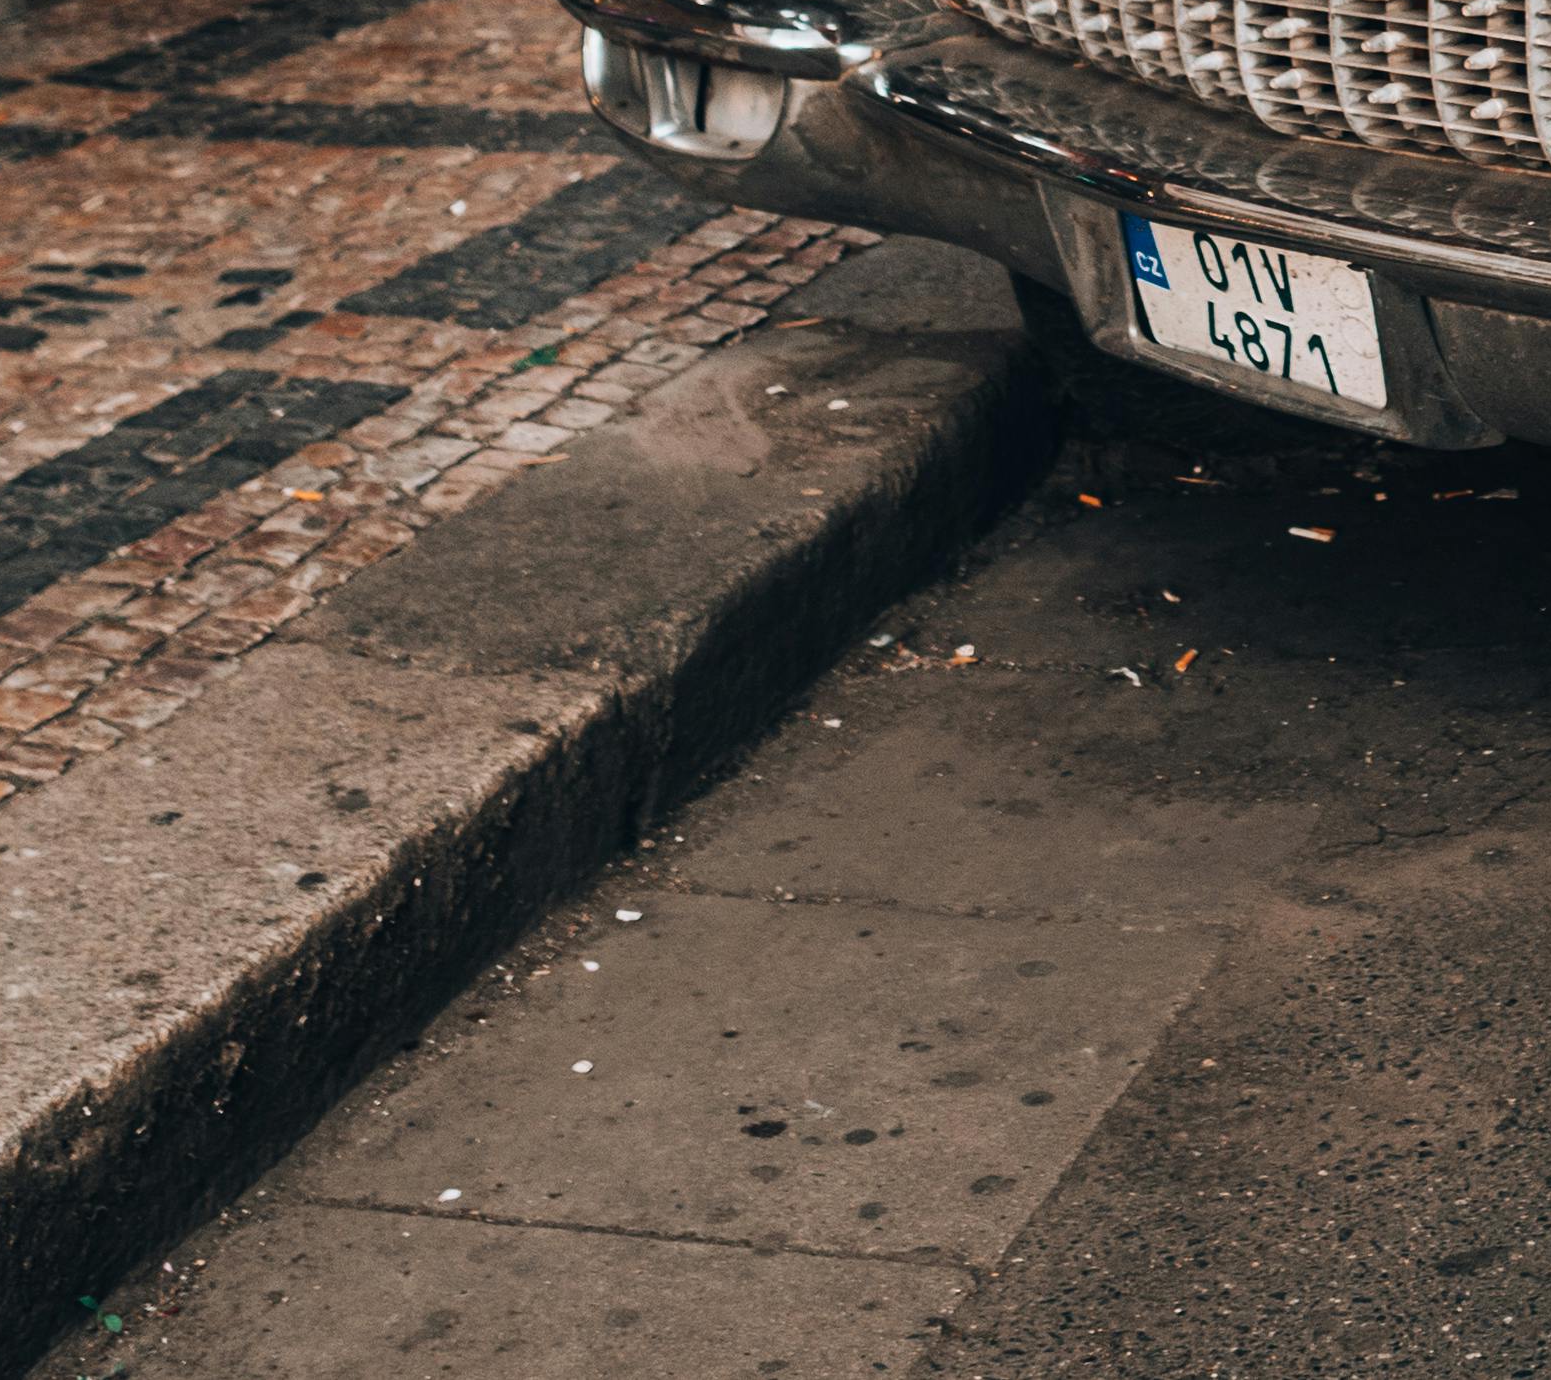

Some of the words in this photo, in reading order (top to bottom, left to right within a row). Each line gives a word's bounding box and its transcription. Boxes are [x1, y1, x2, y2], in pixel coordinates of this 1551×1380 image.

[1135, 249, 1164, 279] CZ
[1192, 231, 1295, 313] 01V
[1207, 300, 1340, 397] 4871
